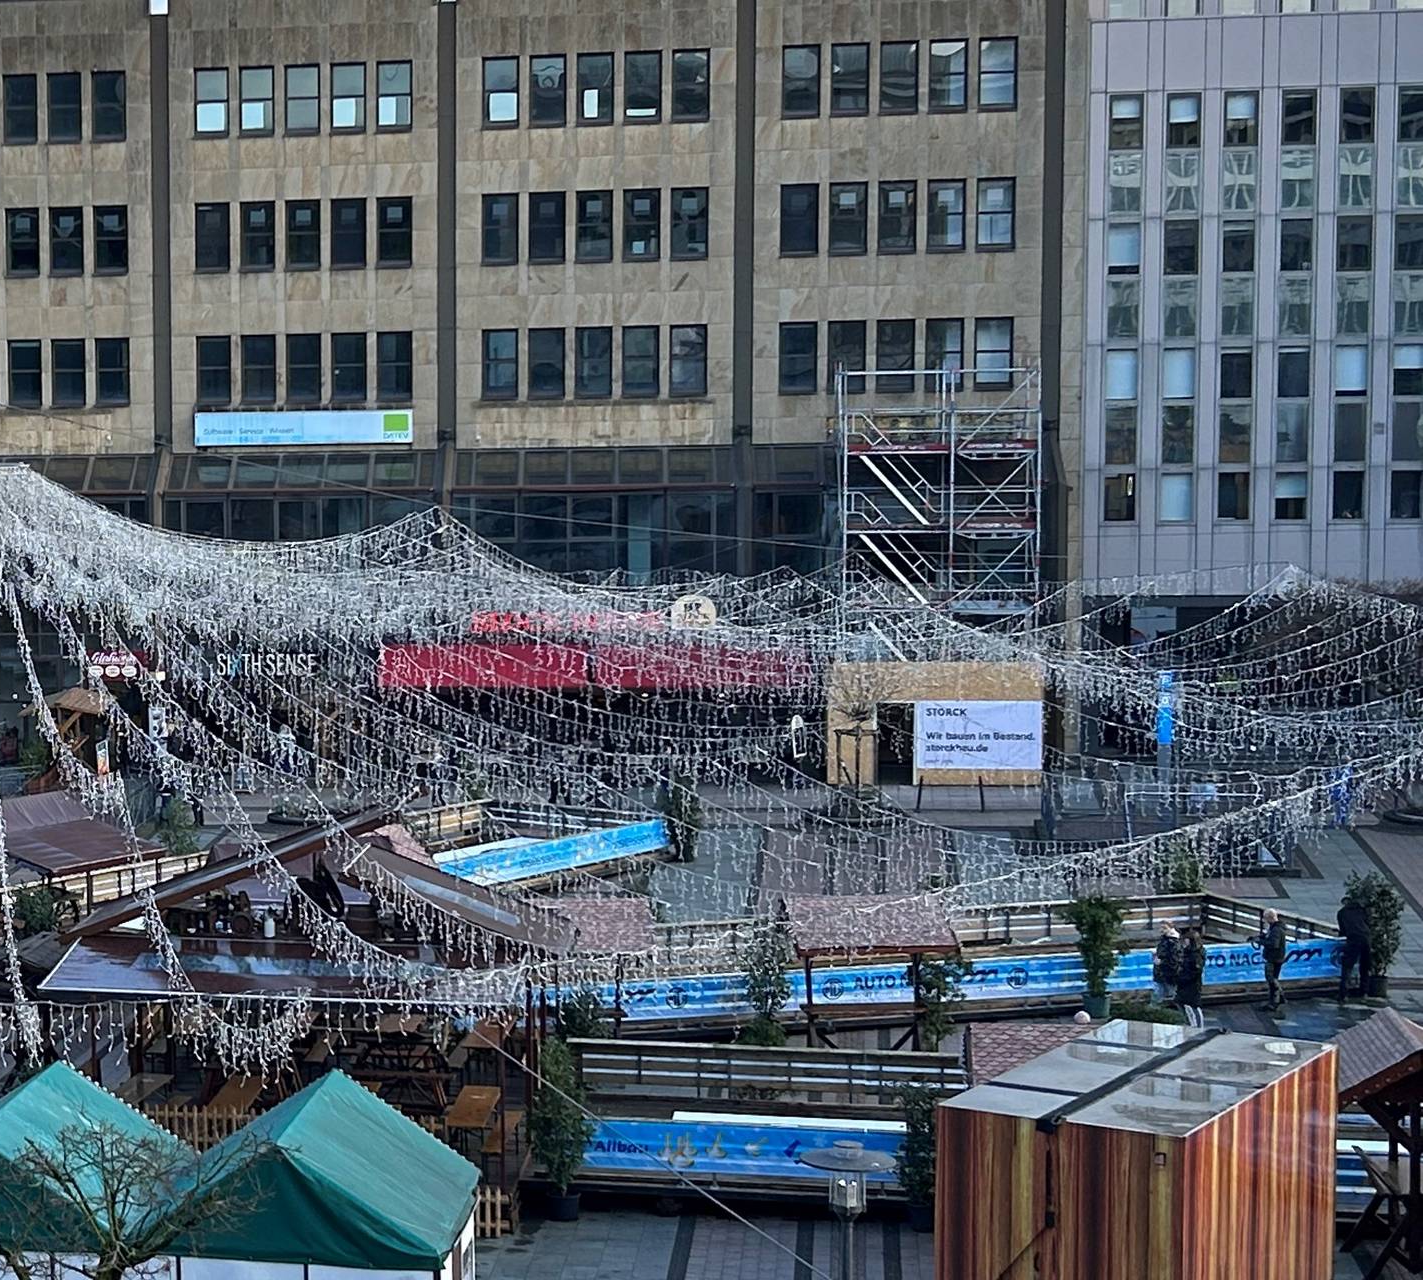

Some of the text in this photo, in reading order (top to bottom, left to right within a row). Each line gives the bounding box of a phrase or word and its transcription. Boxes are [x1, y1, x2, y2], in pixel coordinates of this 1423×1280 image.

[383, 432, 409, 440] DATEV
[266, 653, 318, 677] SENSE
[925, 708, 967, 717] STORCK
[925, 731, 943, 740] Wir
[945, 731, 976, 741] bauen
[978, 731, 991, 740] im
[854, 974, 896, 990] AUTO
